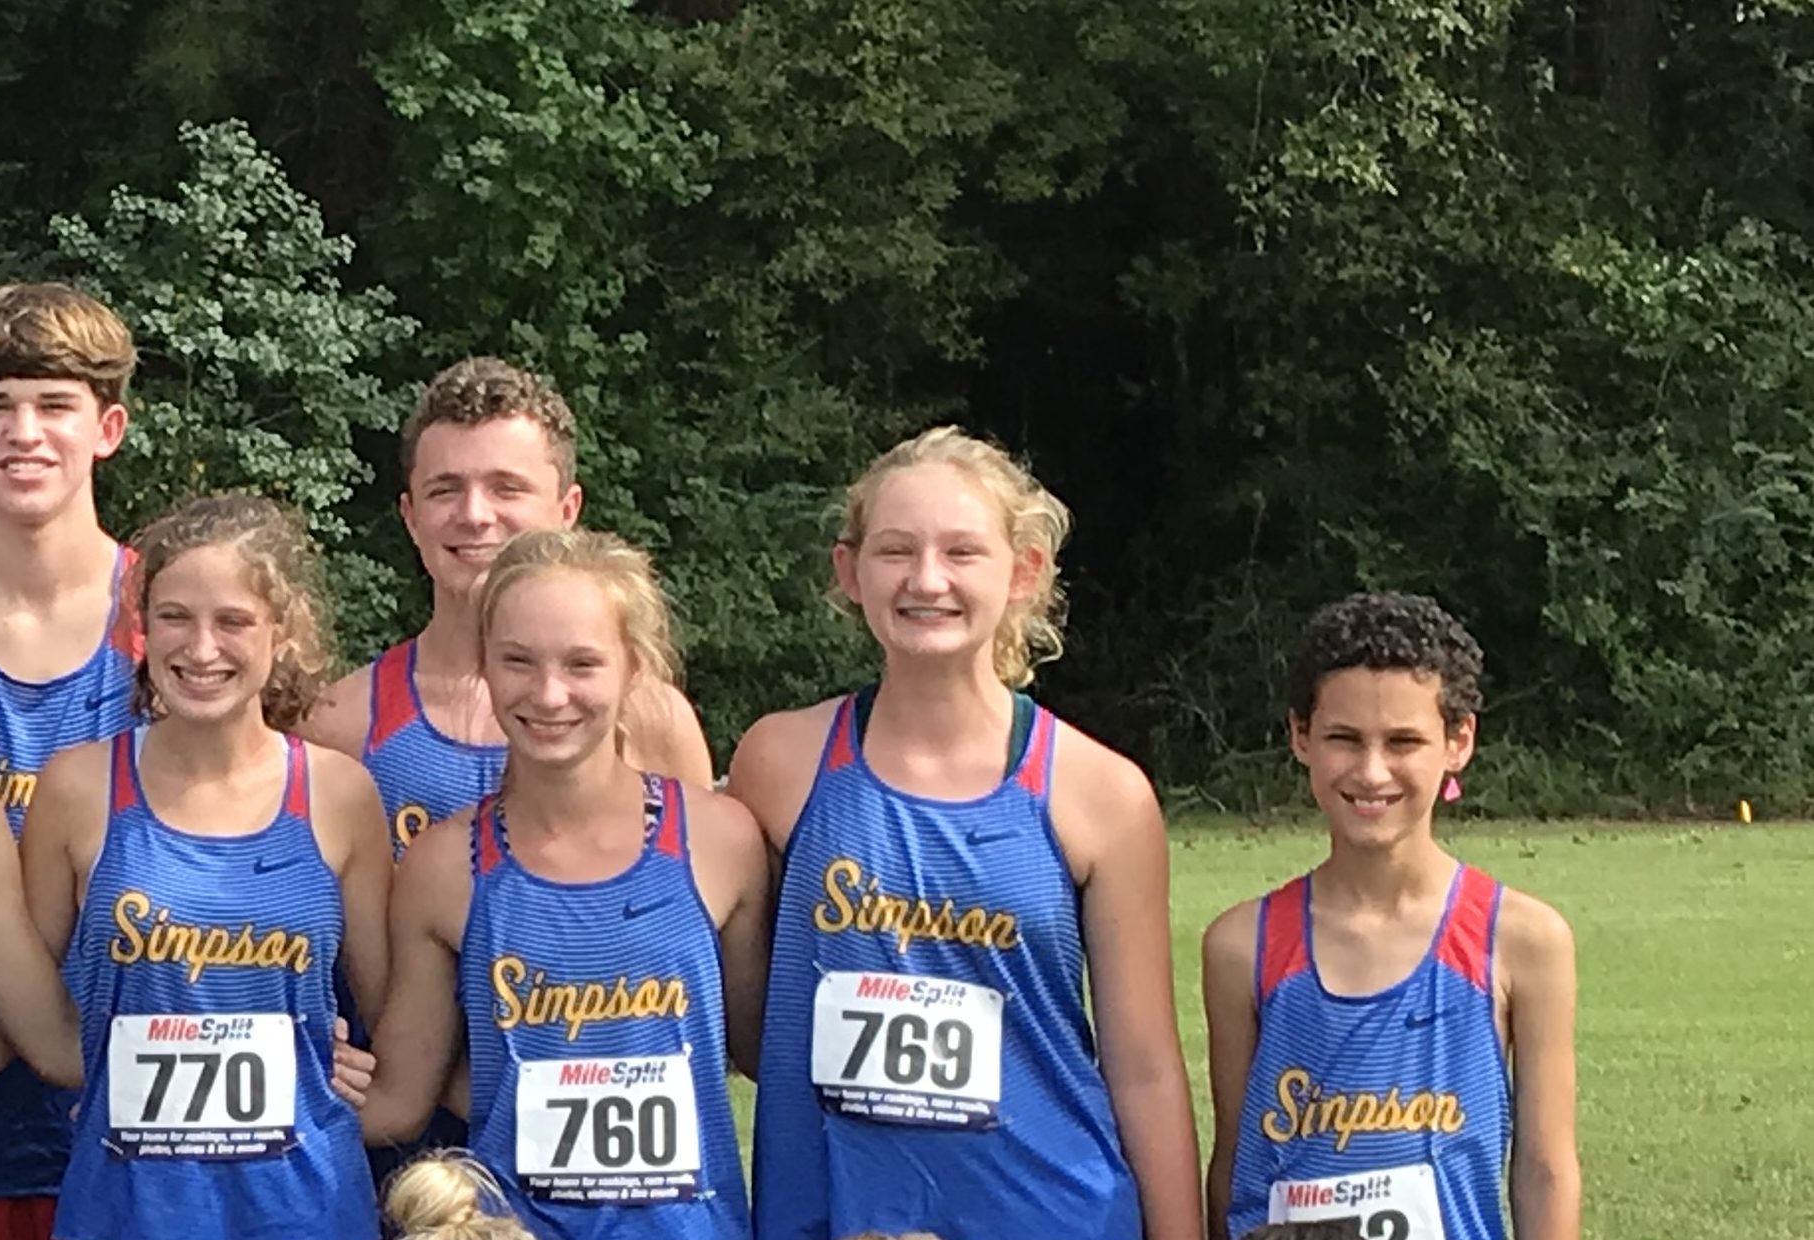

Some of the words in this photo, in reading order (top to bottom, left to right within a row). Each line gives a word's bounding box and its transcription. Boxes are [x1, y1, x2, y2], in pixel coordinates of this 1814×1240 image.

[110, 889, 313, 984] Simpson
[814, 858, 1021, 952] Simpson
[492, 954, 690, 1042] Simpson
[856, 974, 967, 1008] MileSplit
[147, 1018, 254, 1045] MileSplit
[840, 1010, 974, 1090] 769
[135, 1051, 266, 1122] 770
[559, 1061, 666, 1088] MileSplit
[1261, 1068, 1467, 1152] Simpson
[545, 1095, 677, 1168] 760
[1287, 1175, 1392, 1207] MileSplit
